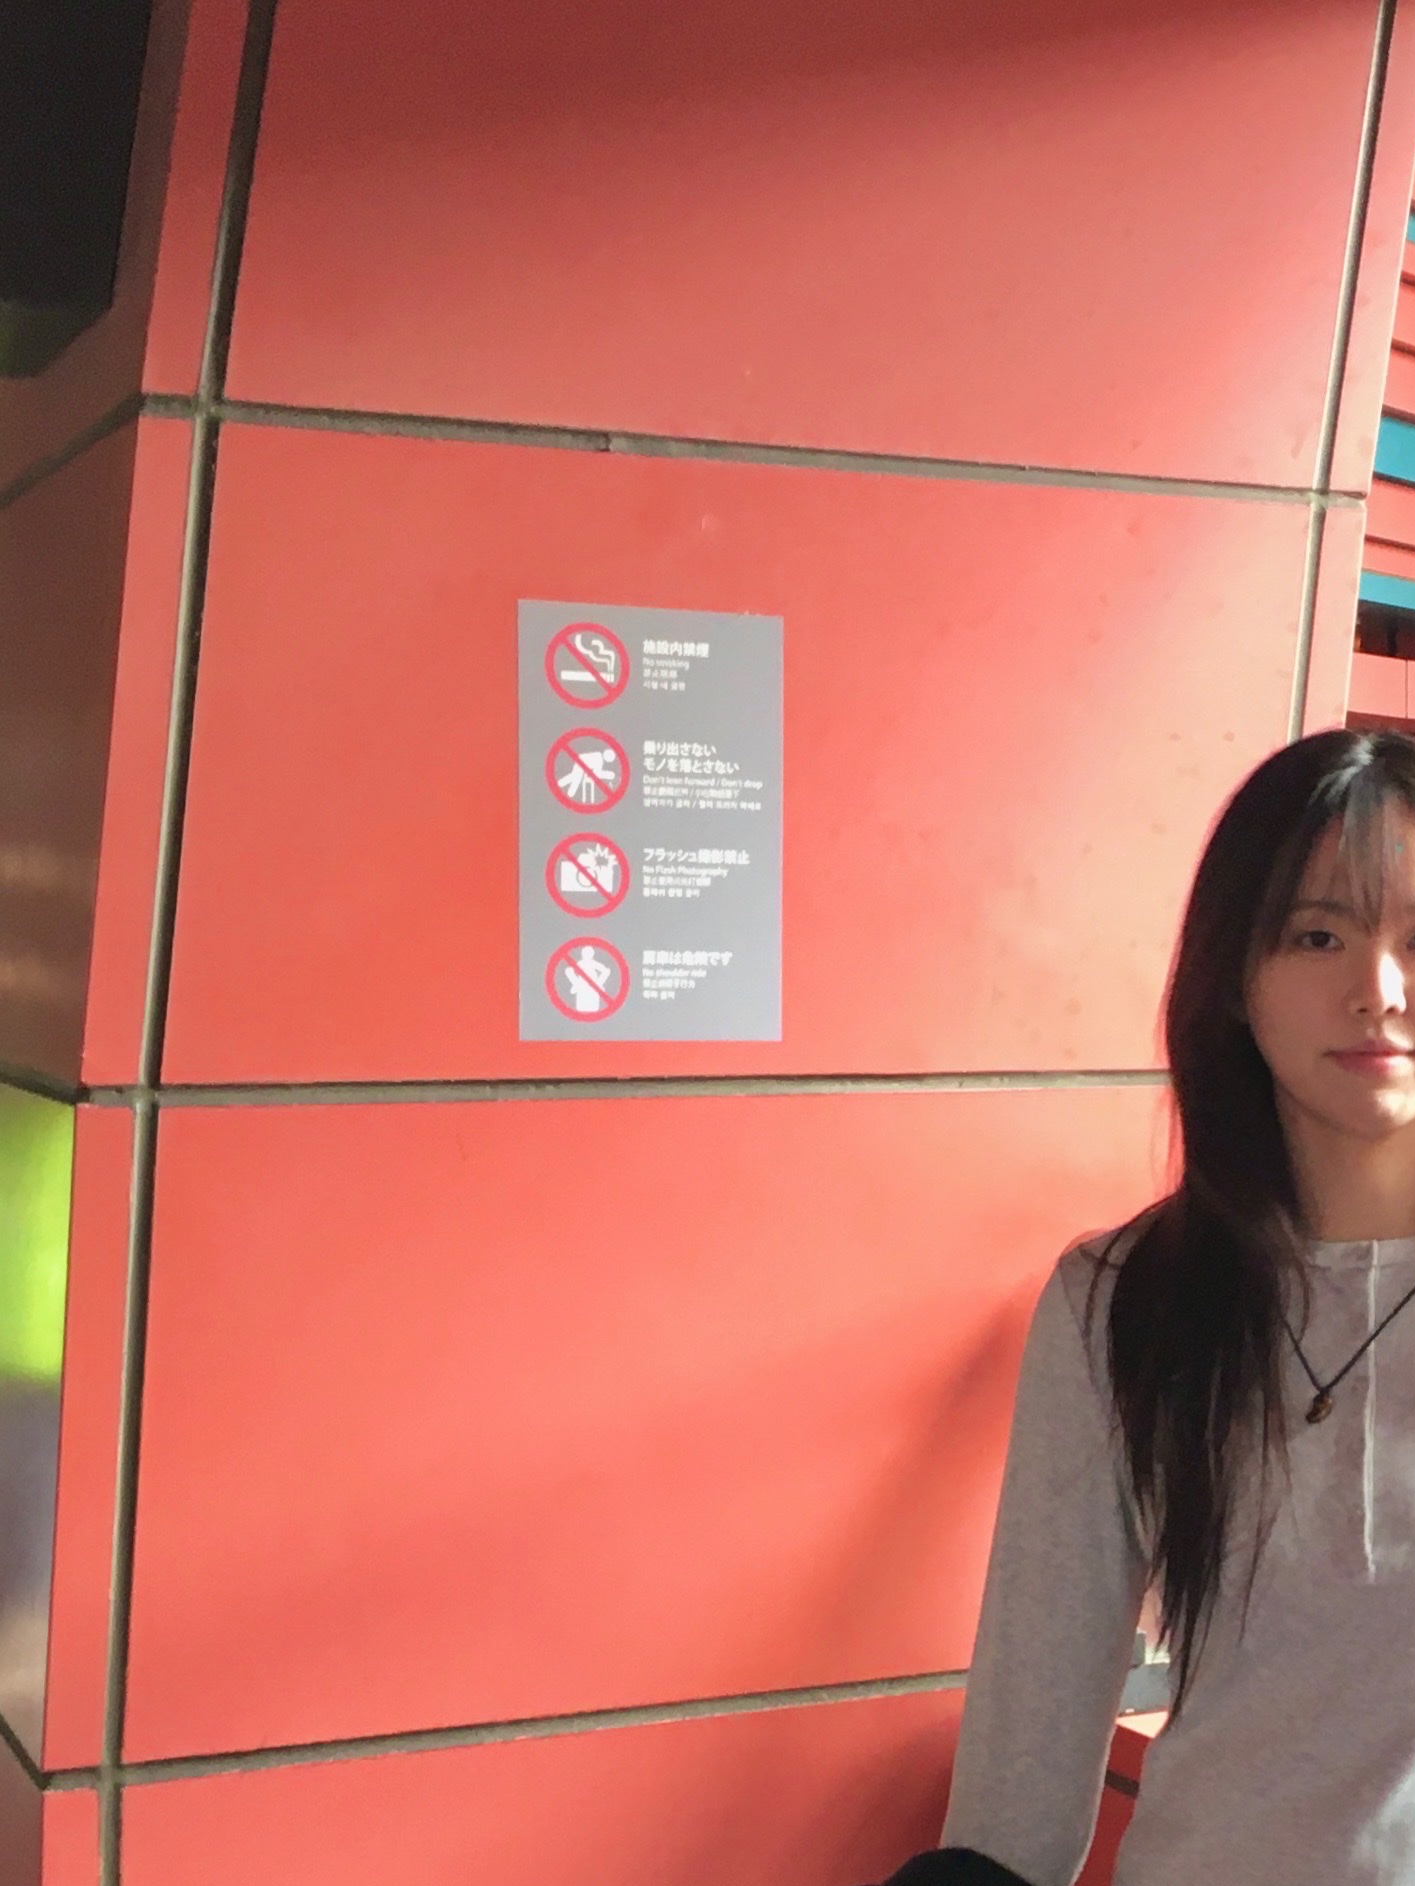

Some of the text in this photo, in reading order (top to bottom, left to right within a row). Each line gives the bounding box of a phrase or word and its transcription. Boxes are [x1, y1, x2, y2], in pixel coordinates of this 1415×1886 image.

[643, 658, 654, 667] No
[643, 757, 740, 774] モノを落とさない
[643, 775, 665, 785] Don't
[744, 780, 763, 790] drop
[642, 865, 655, 874] No
[642, 968, 654, 977] No
